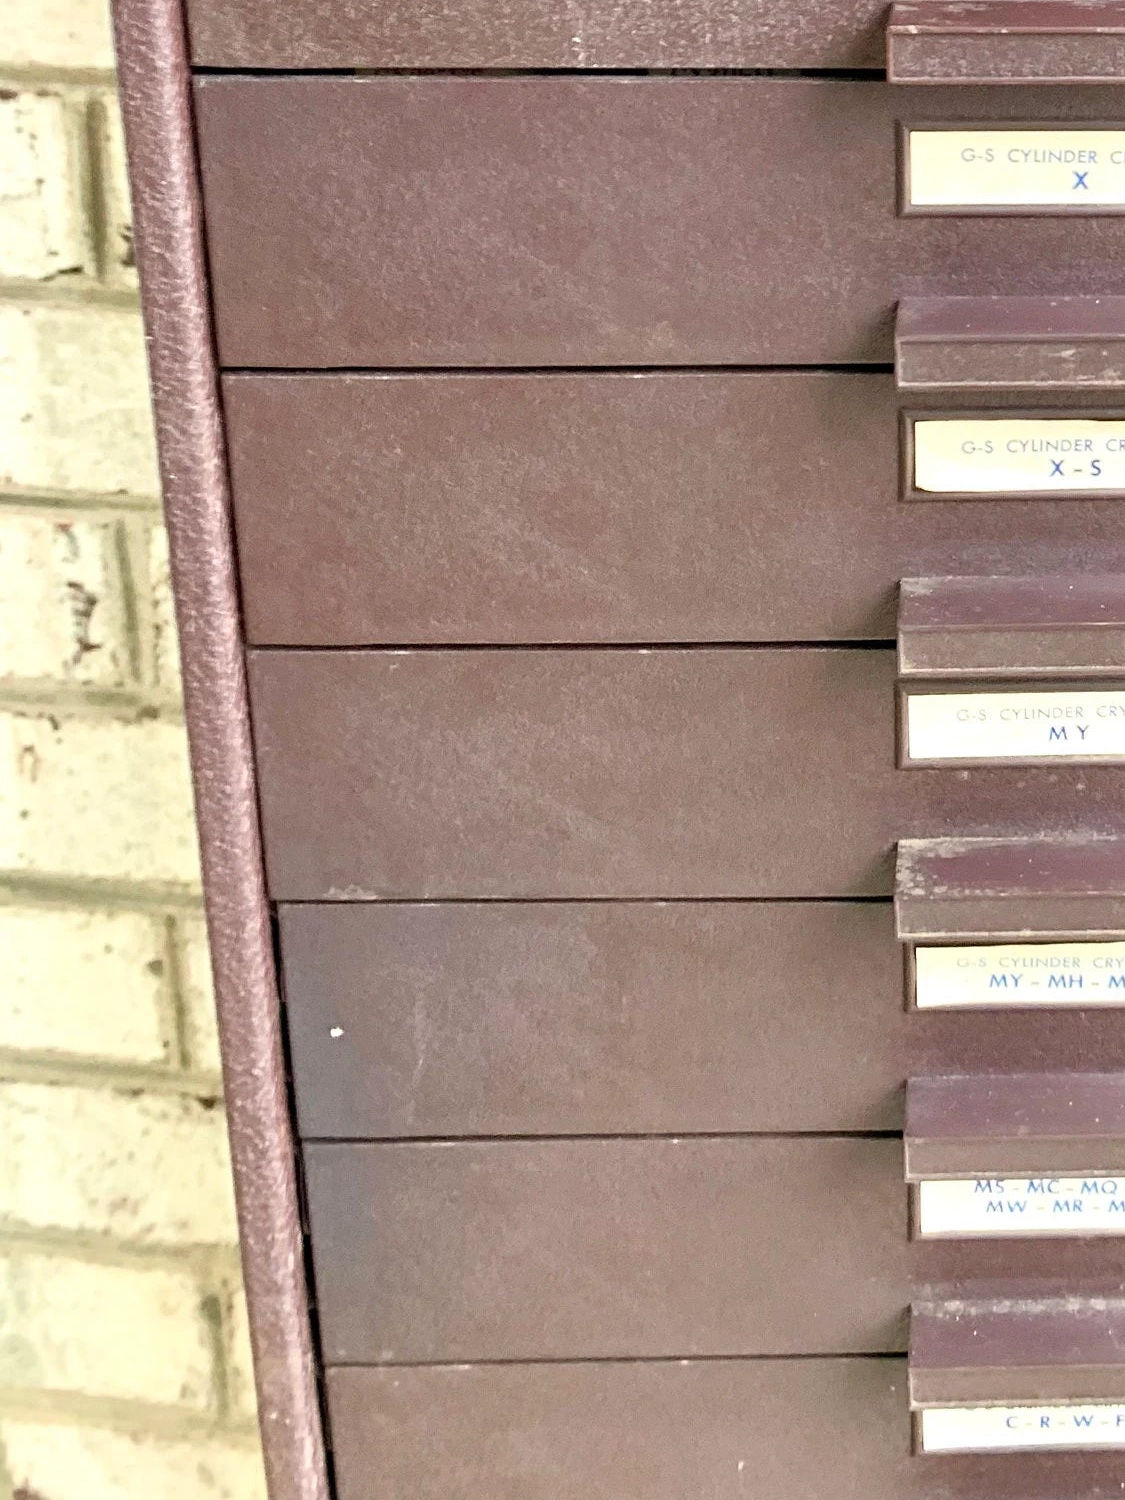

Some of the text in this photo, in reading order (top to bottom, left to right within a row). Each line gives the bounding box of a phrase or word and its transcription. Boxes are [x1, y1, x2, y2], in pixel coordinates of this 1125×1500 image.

[960, 148, 994, 163] G-S
[1008, 148, 1098, 164] CYLINDER
[1072, 171, 1089, 190] X
[961, 440, 994, 454] G-S
[1006, 439, 1094, 453] CYLINDER
[956, 708, 987, 722] G-S
[999, 705, 1084, 720] CYLINDER
[956, 956, 987, 969] G-S
[999, 956, 1081, 970] CYLINDER
